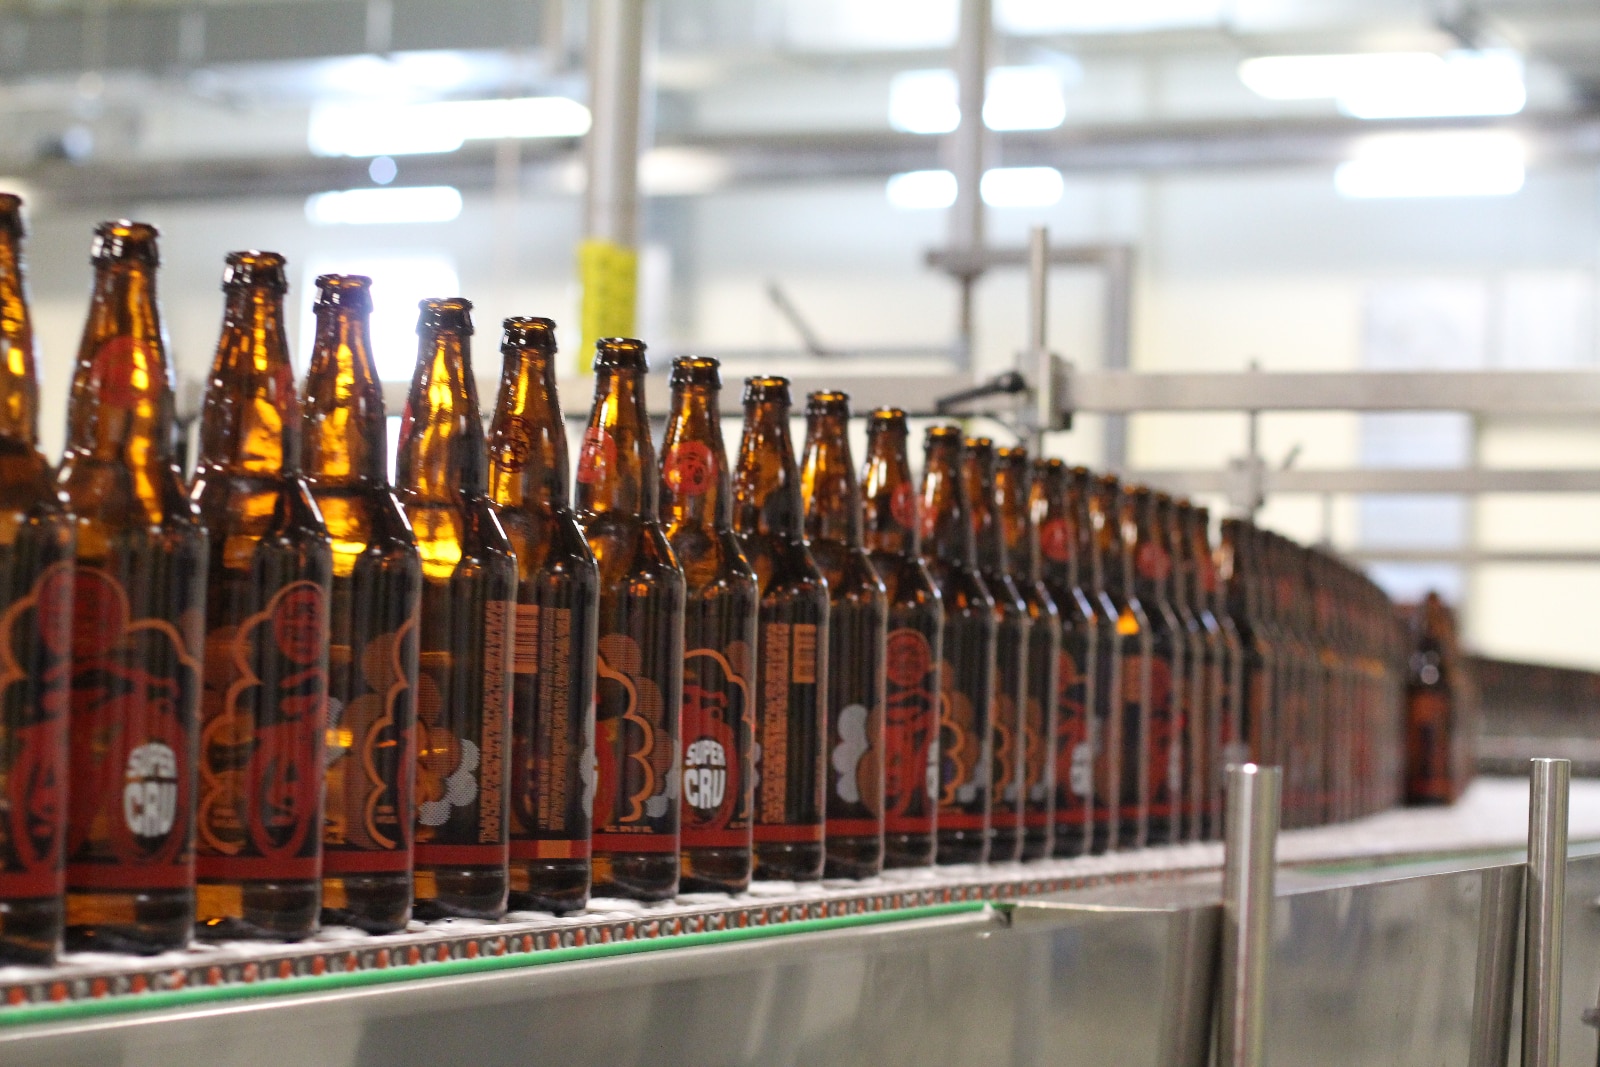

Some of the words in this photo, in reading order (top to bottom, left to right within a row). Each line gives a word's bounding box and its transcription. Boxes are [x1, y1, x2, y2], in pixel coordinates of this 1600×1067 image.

[685, 739, 726, 766] SUPER
[124, 781, 177, 837] CRU
[684, 768, 726, 809] CRU
